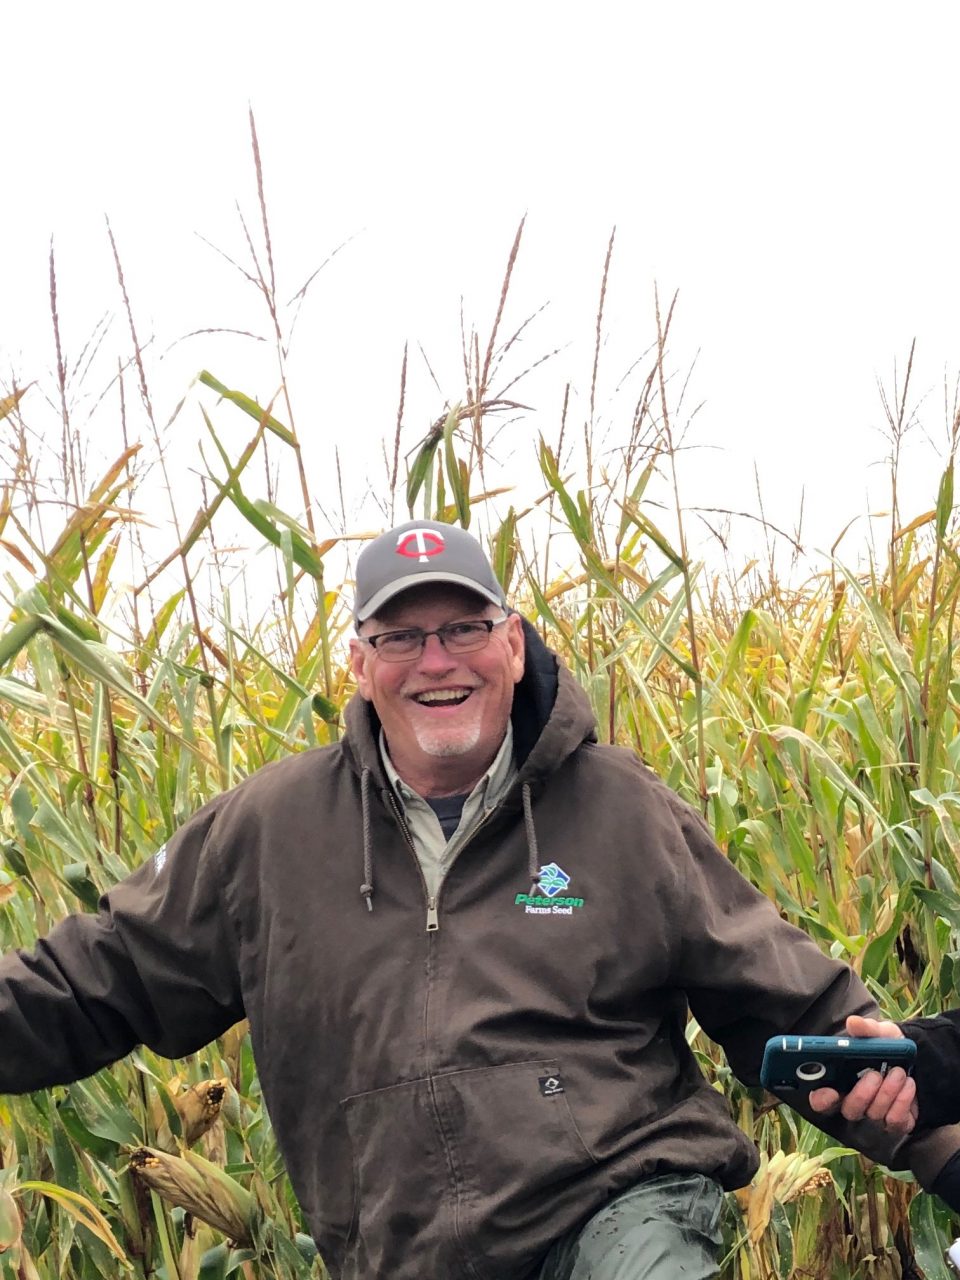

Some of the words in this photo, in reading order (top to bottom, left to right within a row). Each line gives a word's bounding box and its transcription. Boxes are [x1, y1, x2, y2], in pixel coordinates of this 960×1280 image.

[514, 893, 585, 908] Peterson
[525, 905, 551, 915] Farms
[552, 905, 573, 915] Seed
